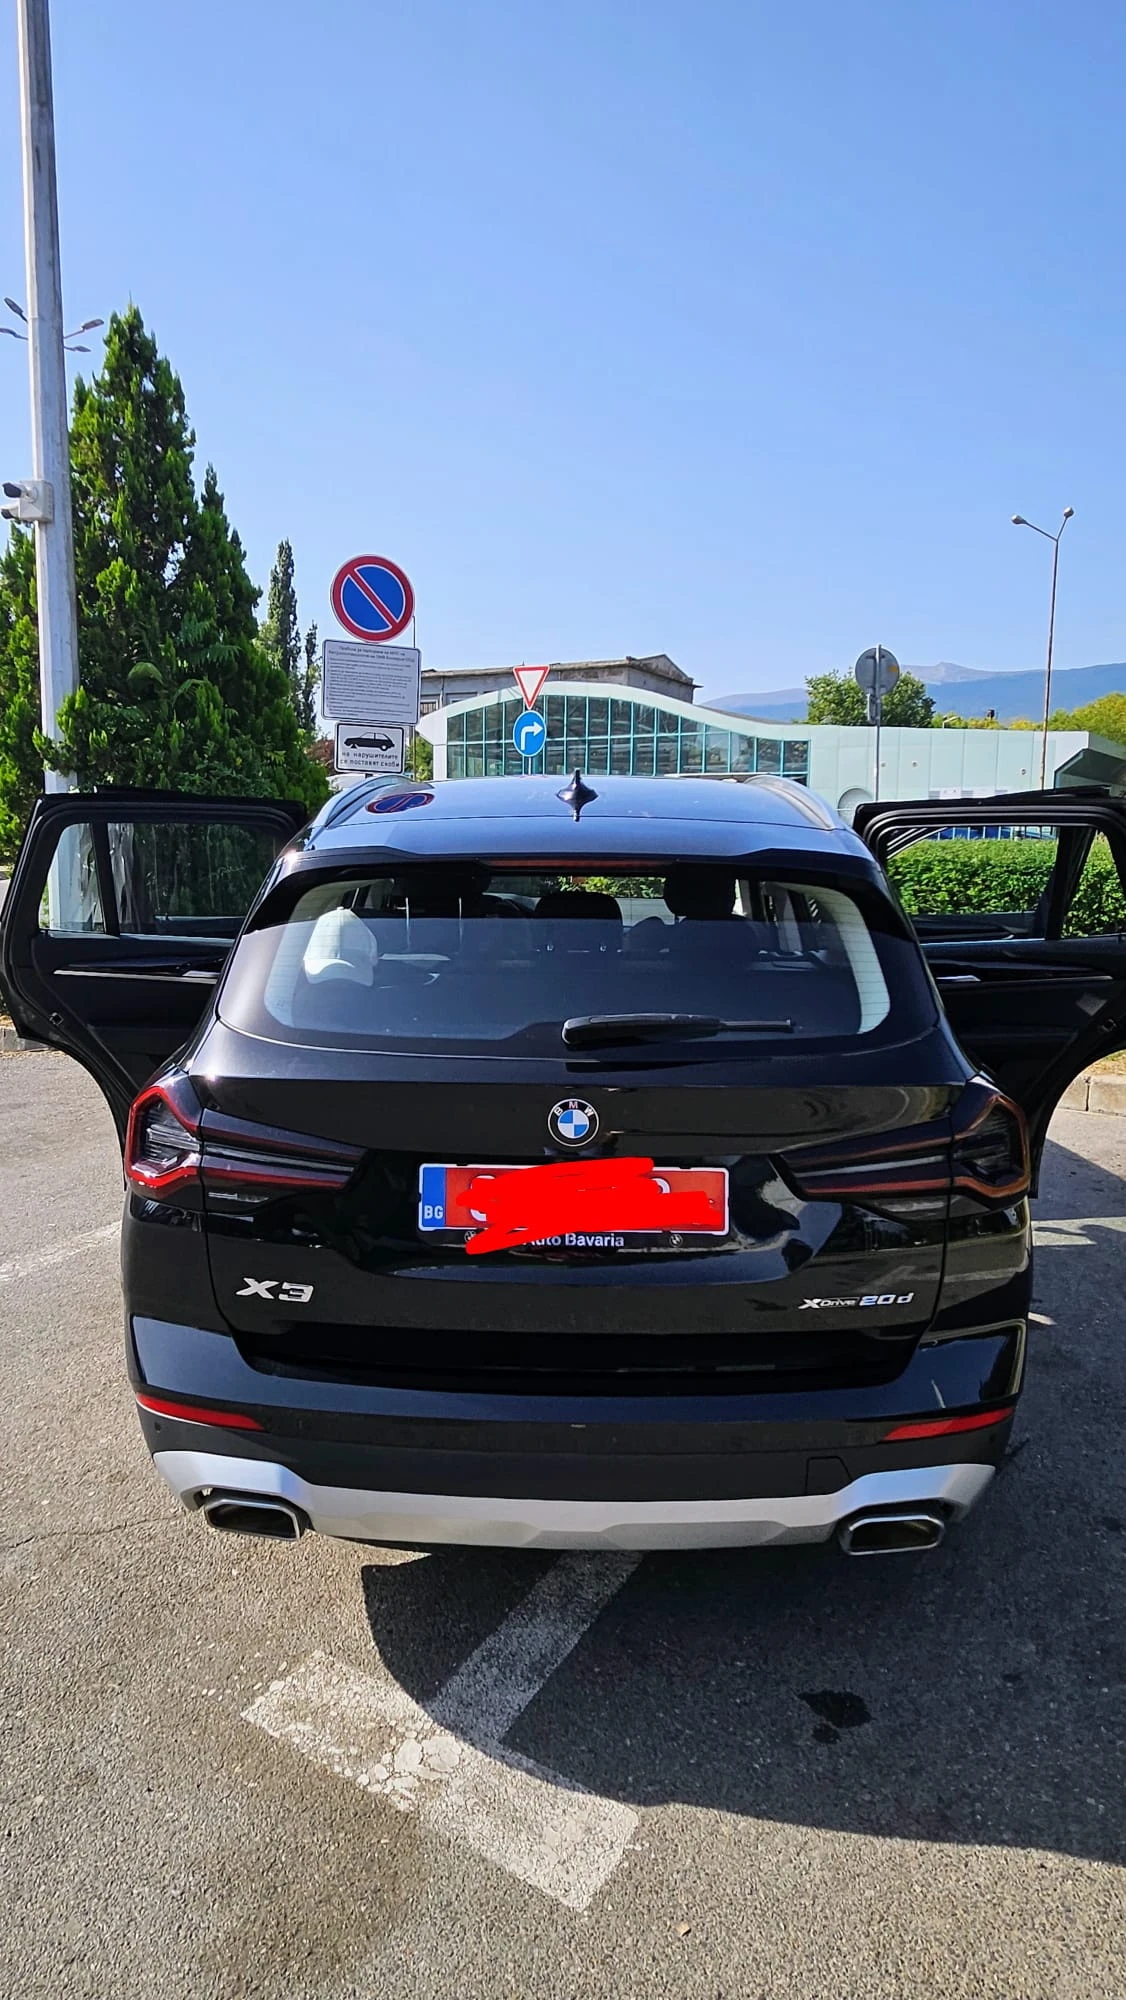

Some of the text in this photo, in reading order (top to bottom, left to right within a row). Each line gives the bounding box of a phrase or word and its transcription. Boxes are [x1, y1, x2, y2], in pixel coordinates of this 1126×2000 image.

[553, 1101, 595, 1117] BMW
[424, 1204, 444, 1219] BG
[565, 1232, 625, 1247] Bavaria
[235, 1277, 314, 1303] X3
